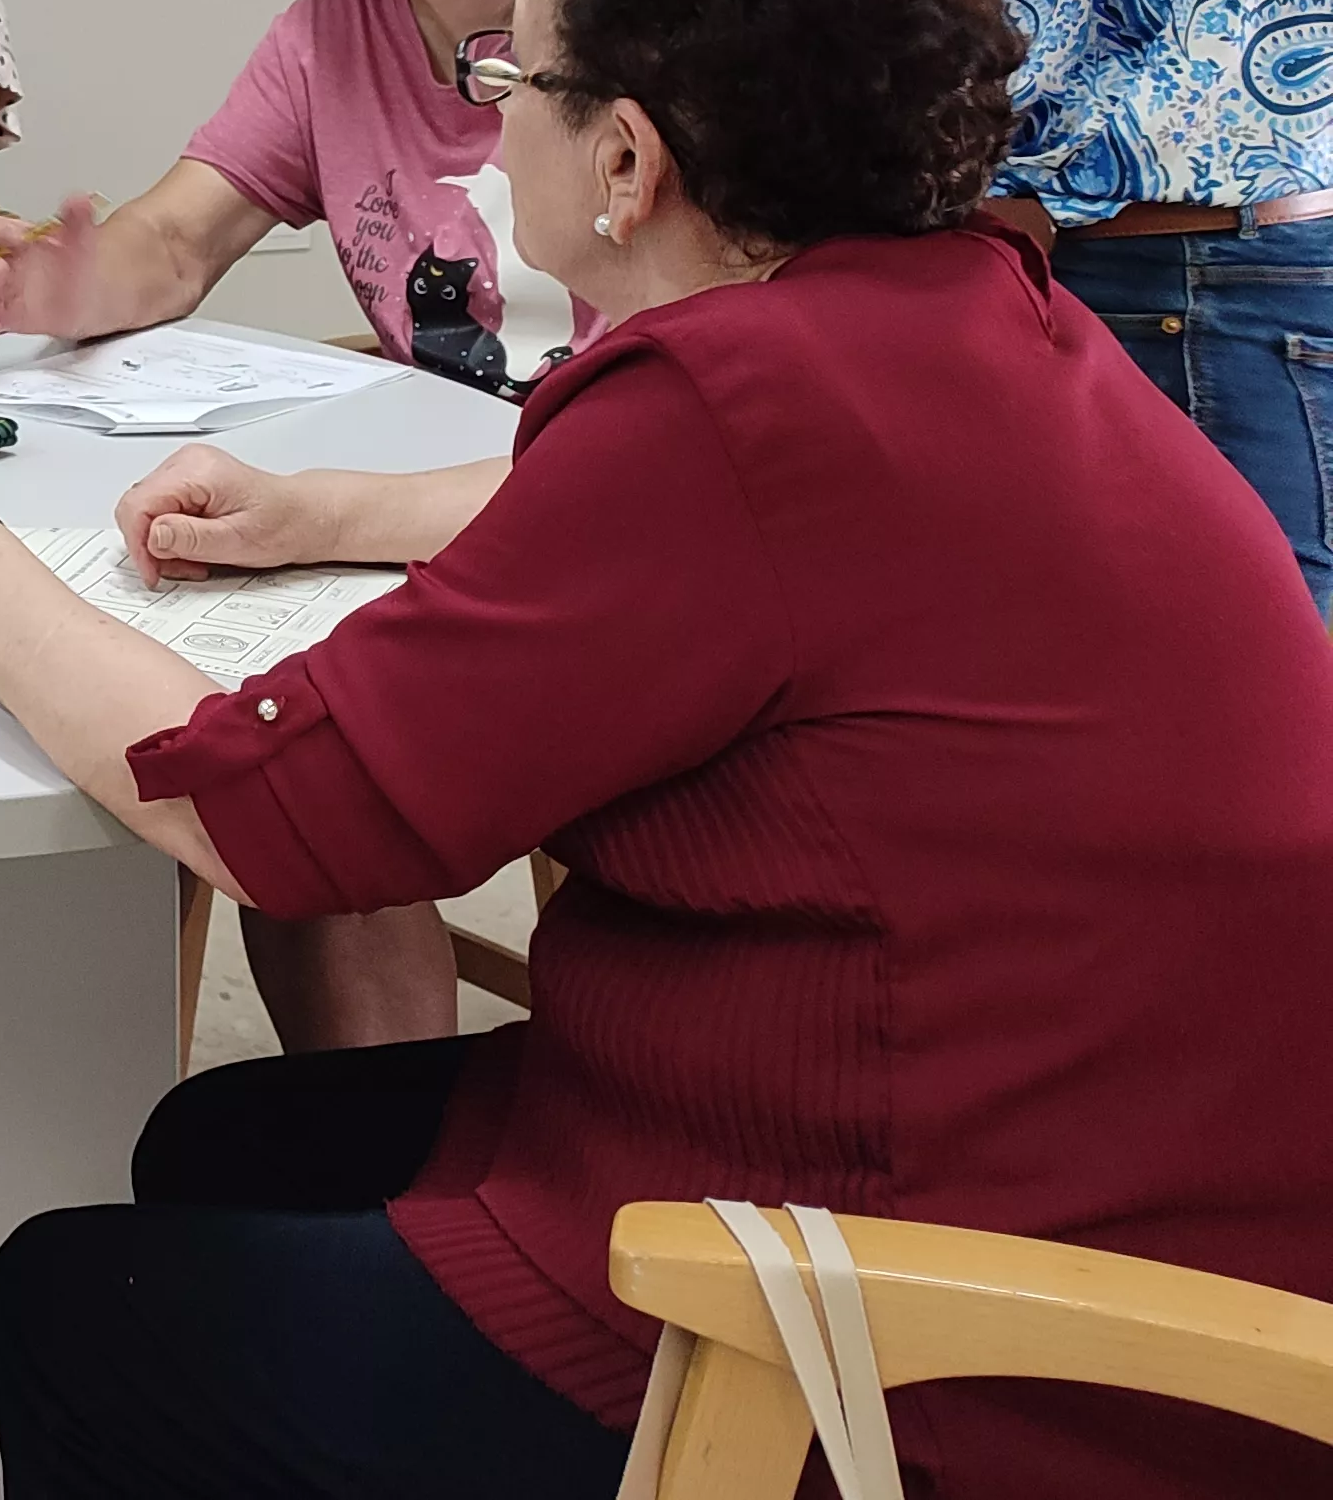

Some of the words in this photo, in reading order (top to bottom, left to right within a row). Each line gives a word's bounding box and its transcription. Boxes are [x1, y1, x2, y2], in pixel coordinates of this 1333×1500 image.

[385, 168, 397, 198] I
[353, 184, 400, 220] Love
[353, 215, 396, 248] you
[355, 245, 390, 273] the
